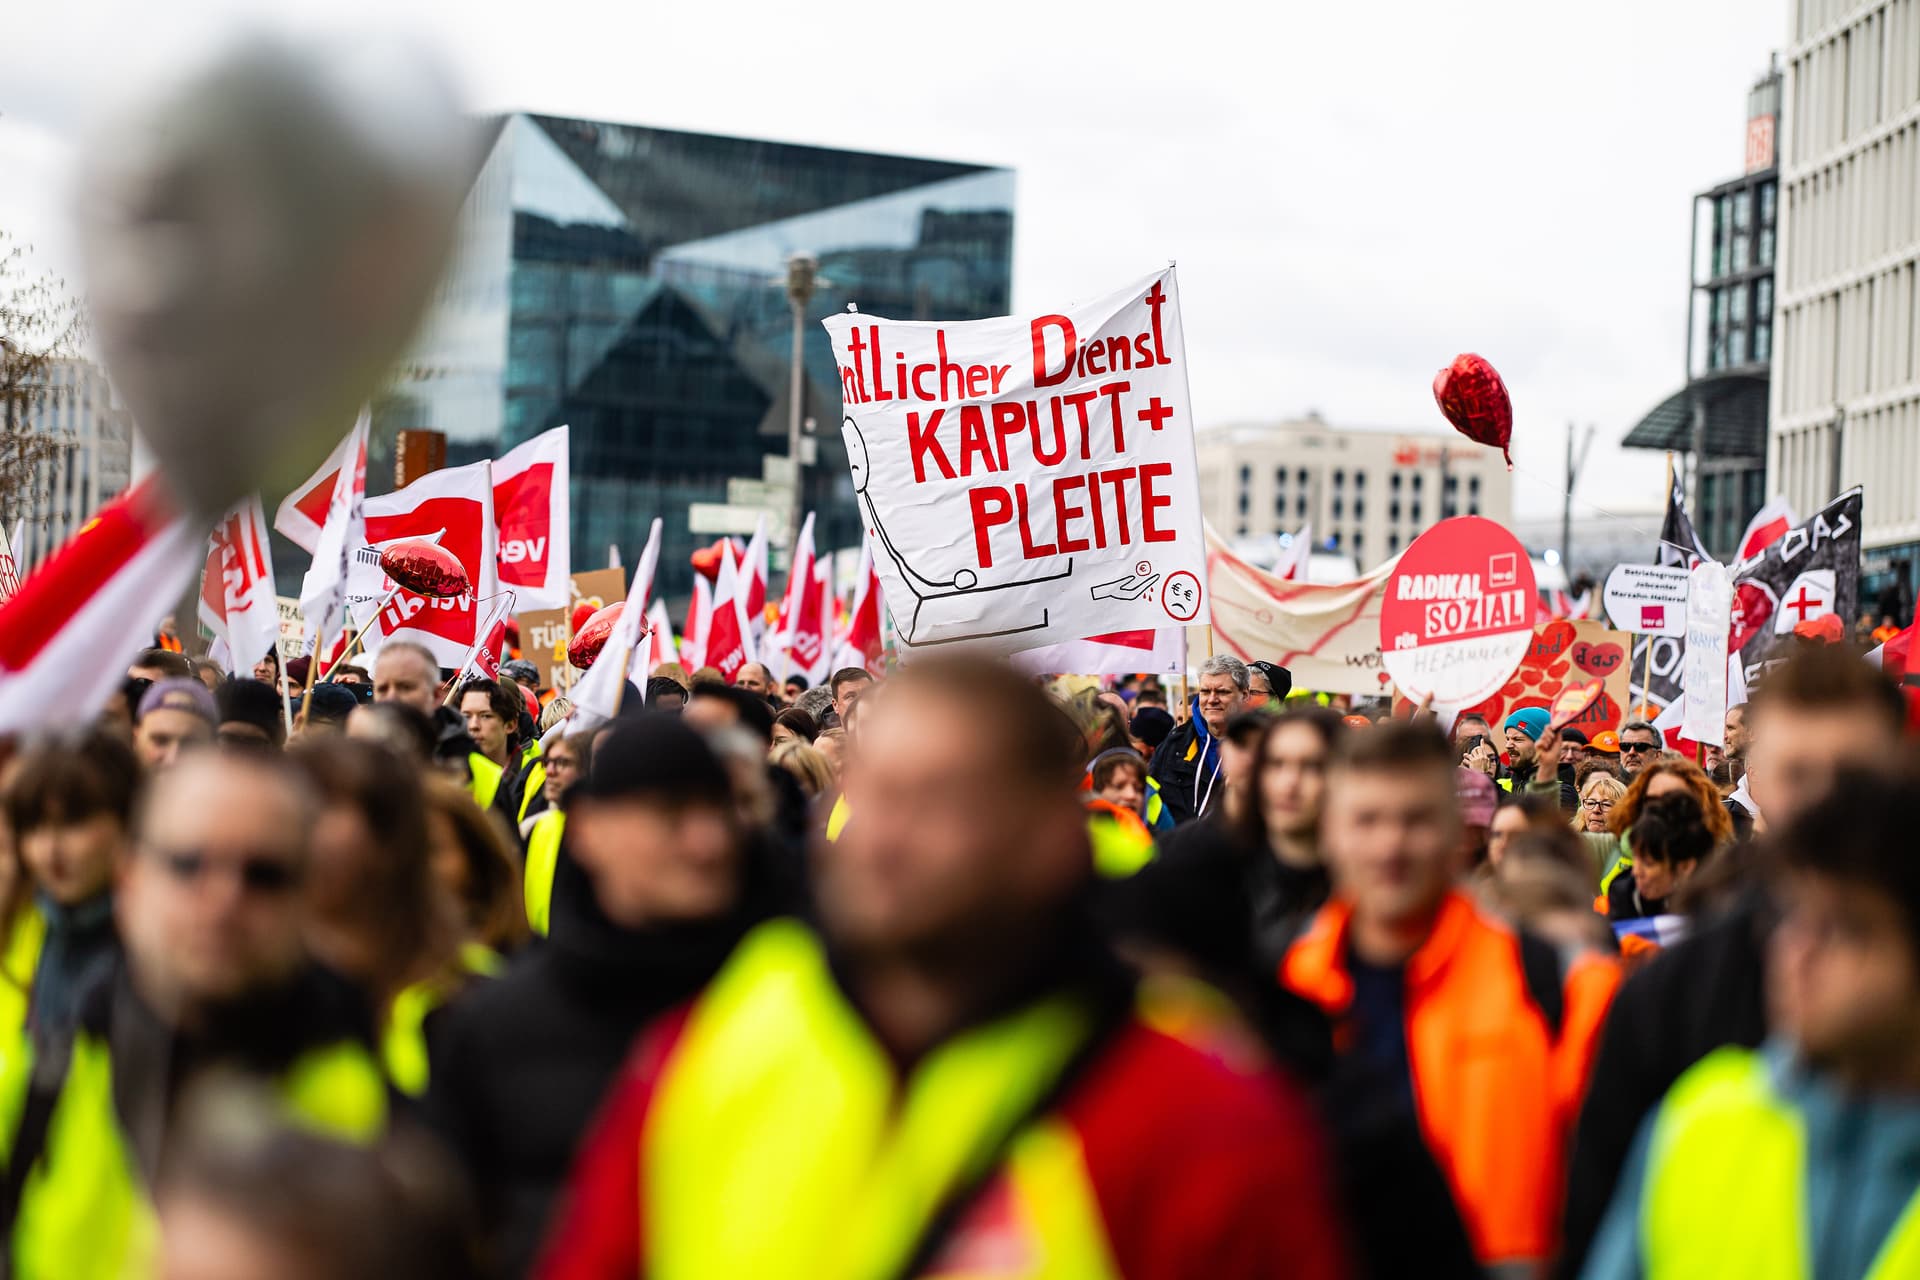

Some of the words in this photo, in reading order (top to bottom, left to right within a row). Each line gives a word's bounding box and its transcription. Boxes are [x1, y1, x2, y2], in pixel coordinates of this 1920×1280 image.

[1031, 279, 1171, 388] Dienst
[906, 382, 1131, 483] KAPUTT
[968, 462, 1176, 569] PLEITE
[1397, 573, 1482, 600] RADIKAL
[1624, 568, 1689, 581] Betriebsgruppe
[1635, 581, 1677, 590] Jobcenter
[1428, 589, 1523, 636] SOZIAL
[1575, 648, 1619, 666] das
